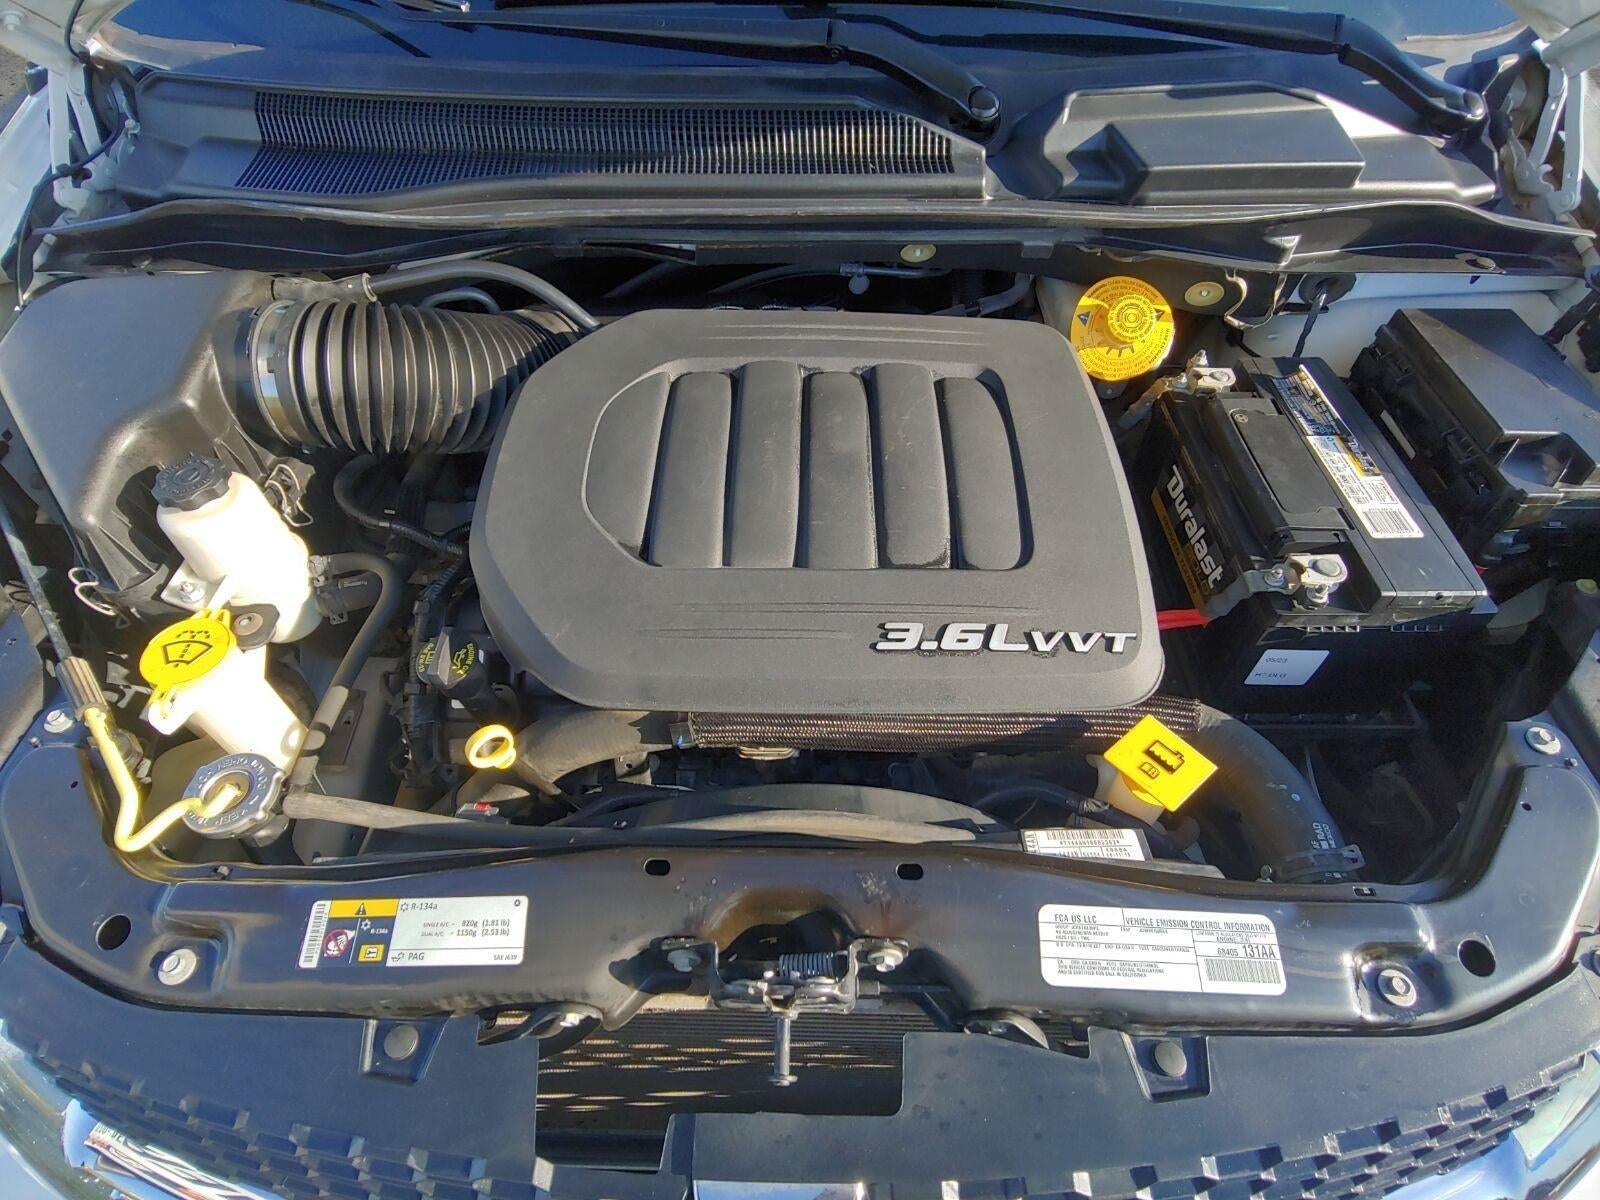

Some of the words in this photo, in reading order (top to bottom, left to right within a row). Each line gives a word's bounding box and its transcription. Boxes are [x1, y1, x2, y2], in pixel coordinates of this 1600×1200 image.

[1166, 464, 1225, 589] Duralast
[873, 622, 1029, 651] 3.6L
[1029, 631, 1137, 653] VVT
[462, 920, 478, 928] 820g
[482, 919, 499, 928] (1.81
[500, 919, 510, 927] lb)
[1055, 914, 1068, 922] FCA
[1071, 914, 1081, 923] US
[1084, 915, 1097, 924] LLC
[1126, 917, 1154, 926] VEHICLE
[1156, 918, 1189, 928] EMISSION
[1191, 920, 1221, 930] CONTROL
[1224, 922, 1270, 932] INFORMATION
[457, 929, 477, 937] 1150g
[482, 929, 498, 937] (2.53
[500, 928, 510, 936] lb)
[408, 952, 425, 960] PAG
[1218, 948, 1238, 956] 68405
[1243, 944, 1276, 958] 131AA
